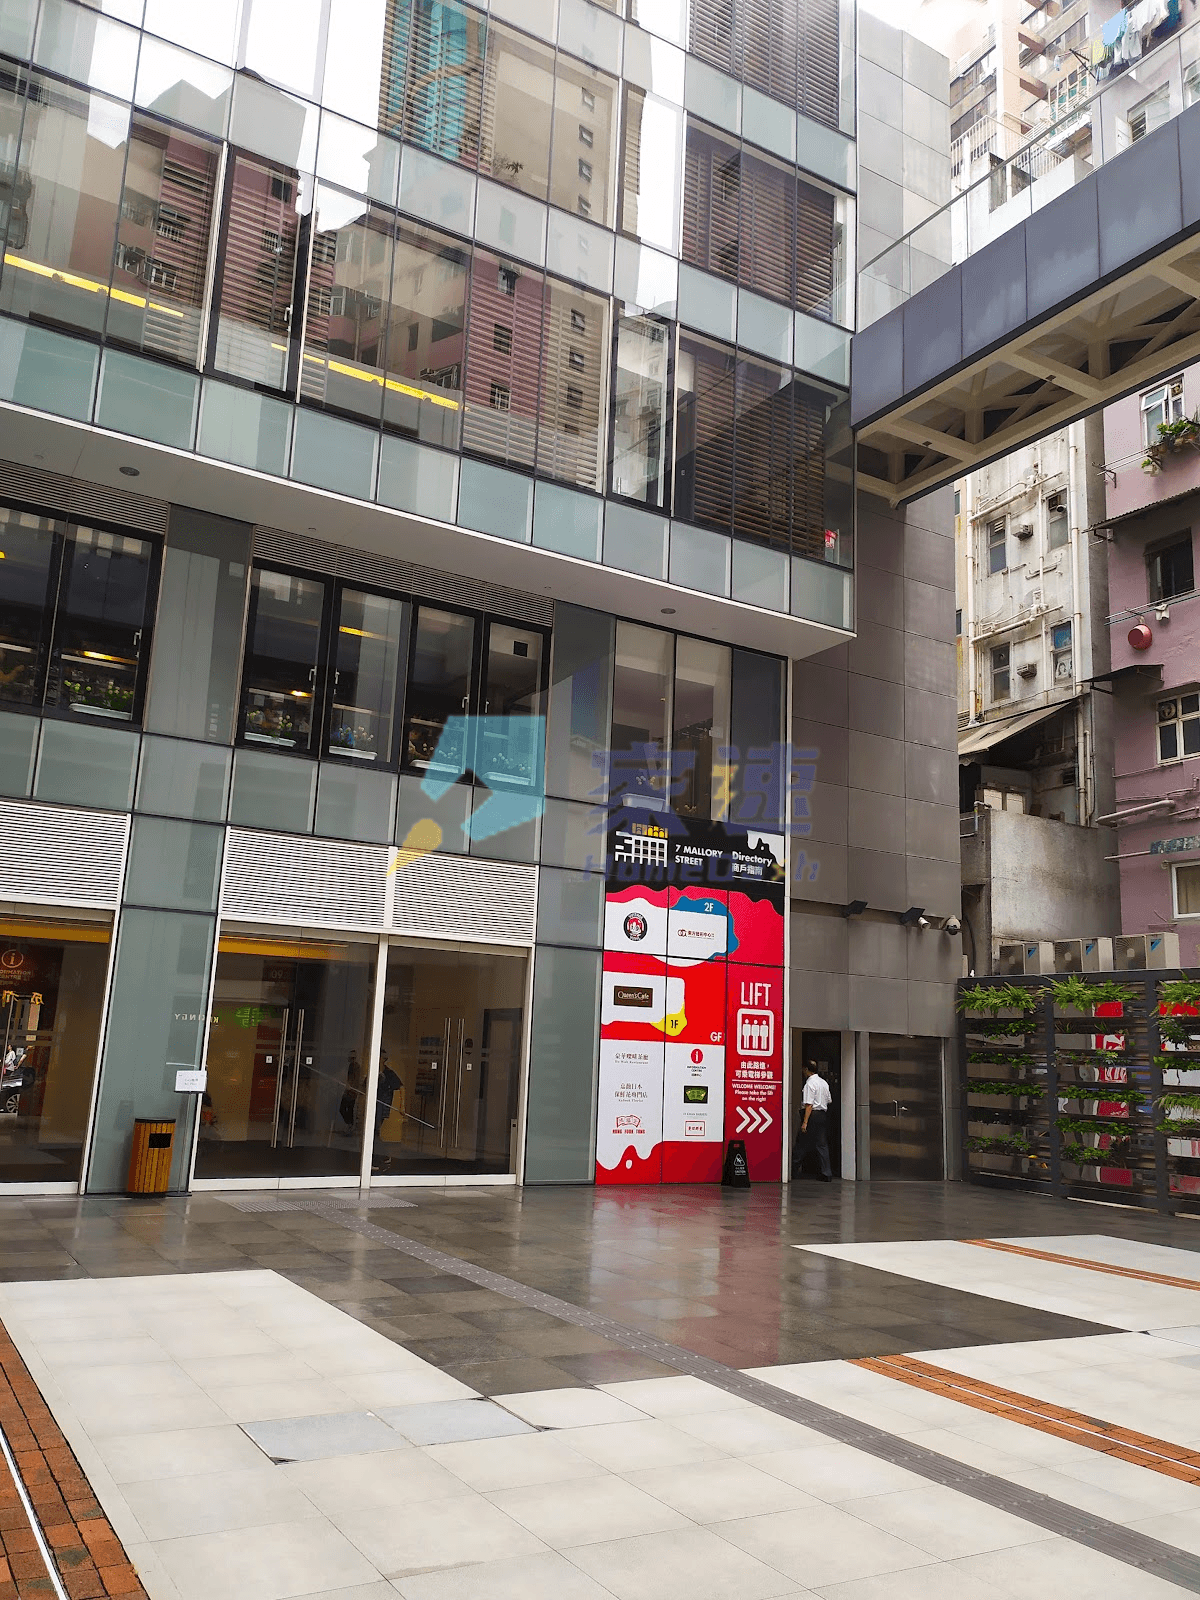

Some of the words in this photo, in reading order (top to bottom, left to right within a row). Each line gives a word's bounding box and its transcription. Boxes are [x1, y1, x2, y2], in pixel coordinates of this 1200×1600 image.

[675, 844, 681, 853] 7
[683, 846, 723, 858] MALLORY
[674, 855, 703, 866] STREET
[732, 851, 772, 867] Directory
[704, 902, 714, 912] 2F
[740, 981, 772, 1006] LIFT
[670, 1020, 679, 1029] 1F
[709, 1031, 723, 1042] GF
